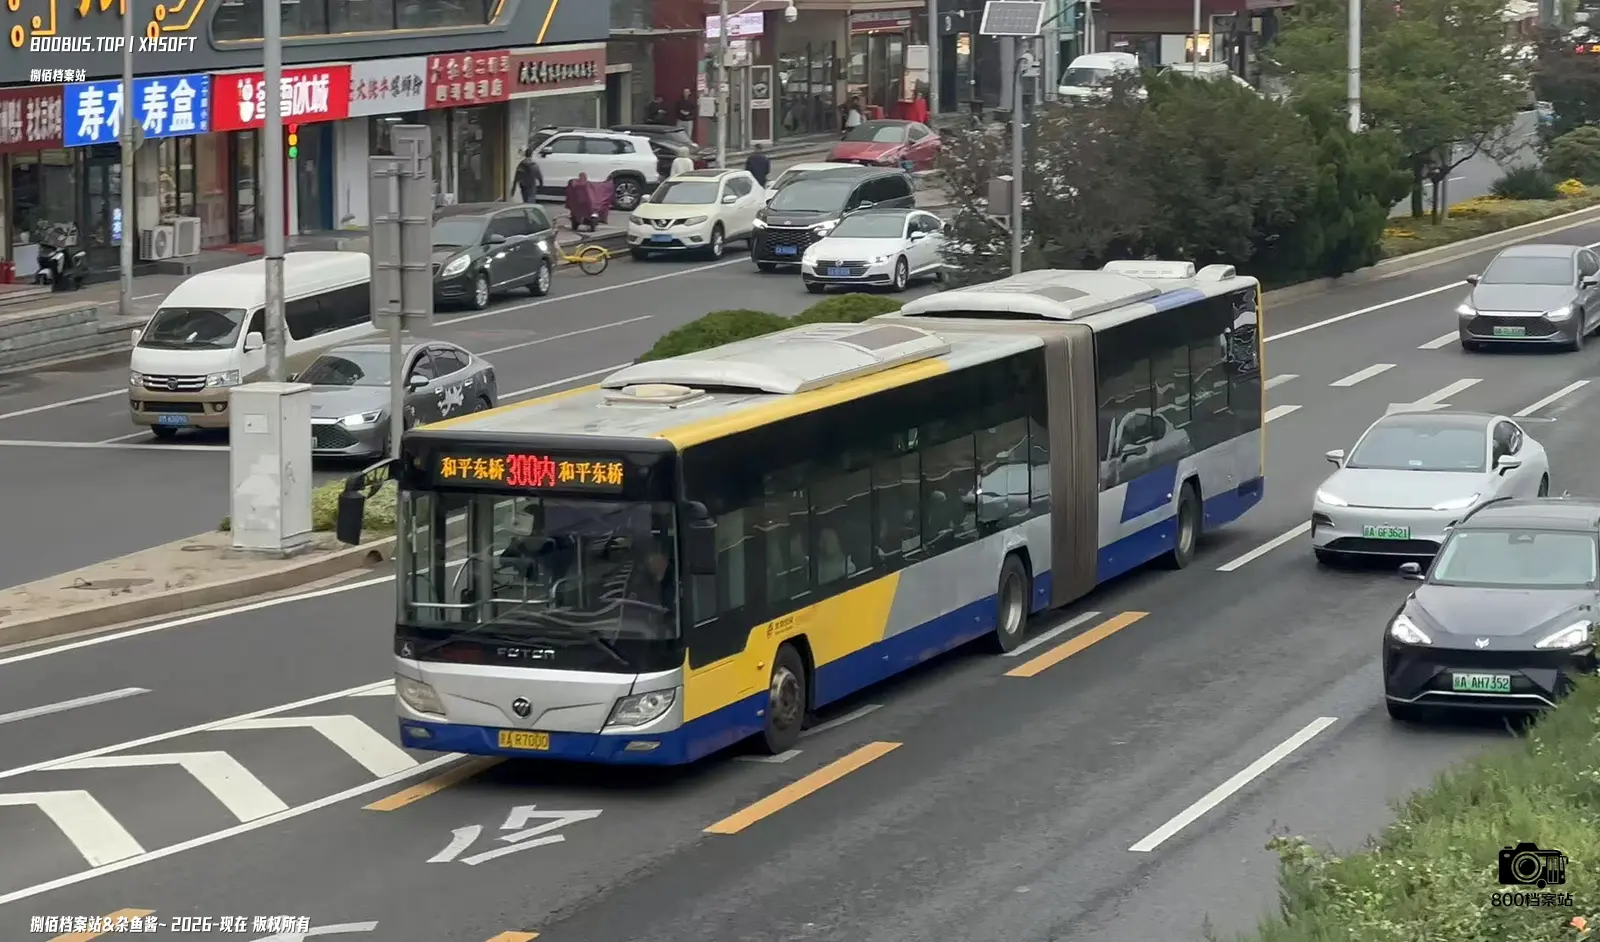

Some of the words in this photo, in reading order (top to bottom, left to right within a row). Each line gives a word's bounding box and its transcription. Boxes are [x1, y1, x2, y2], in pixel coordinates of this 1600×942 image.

[440, 457, 504, 480] 和平东桥
[506, 454, 556, 486] 300内
[558, 461, 624, 485] 和平东桥
[497, 647, 555, 660] FOTON
